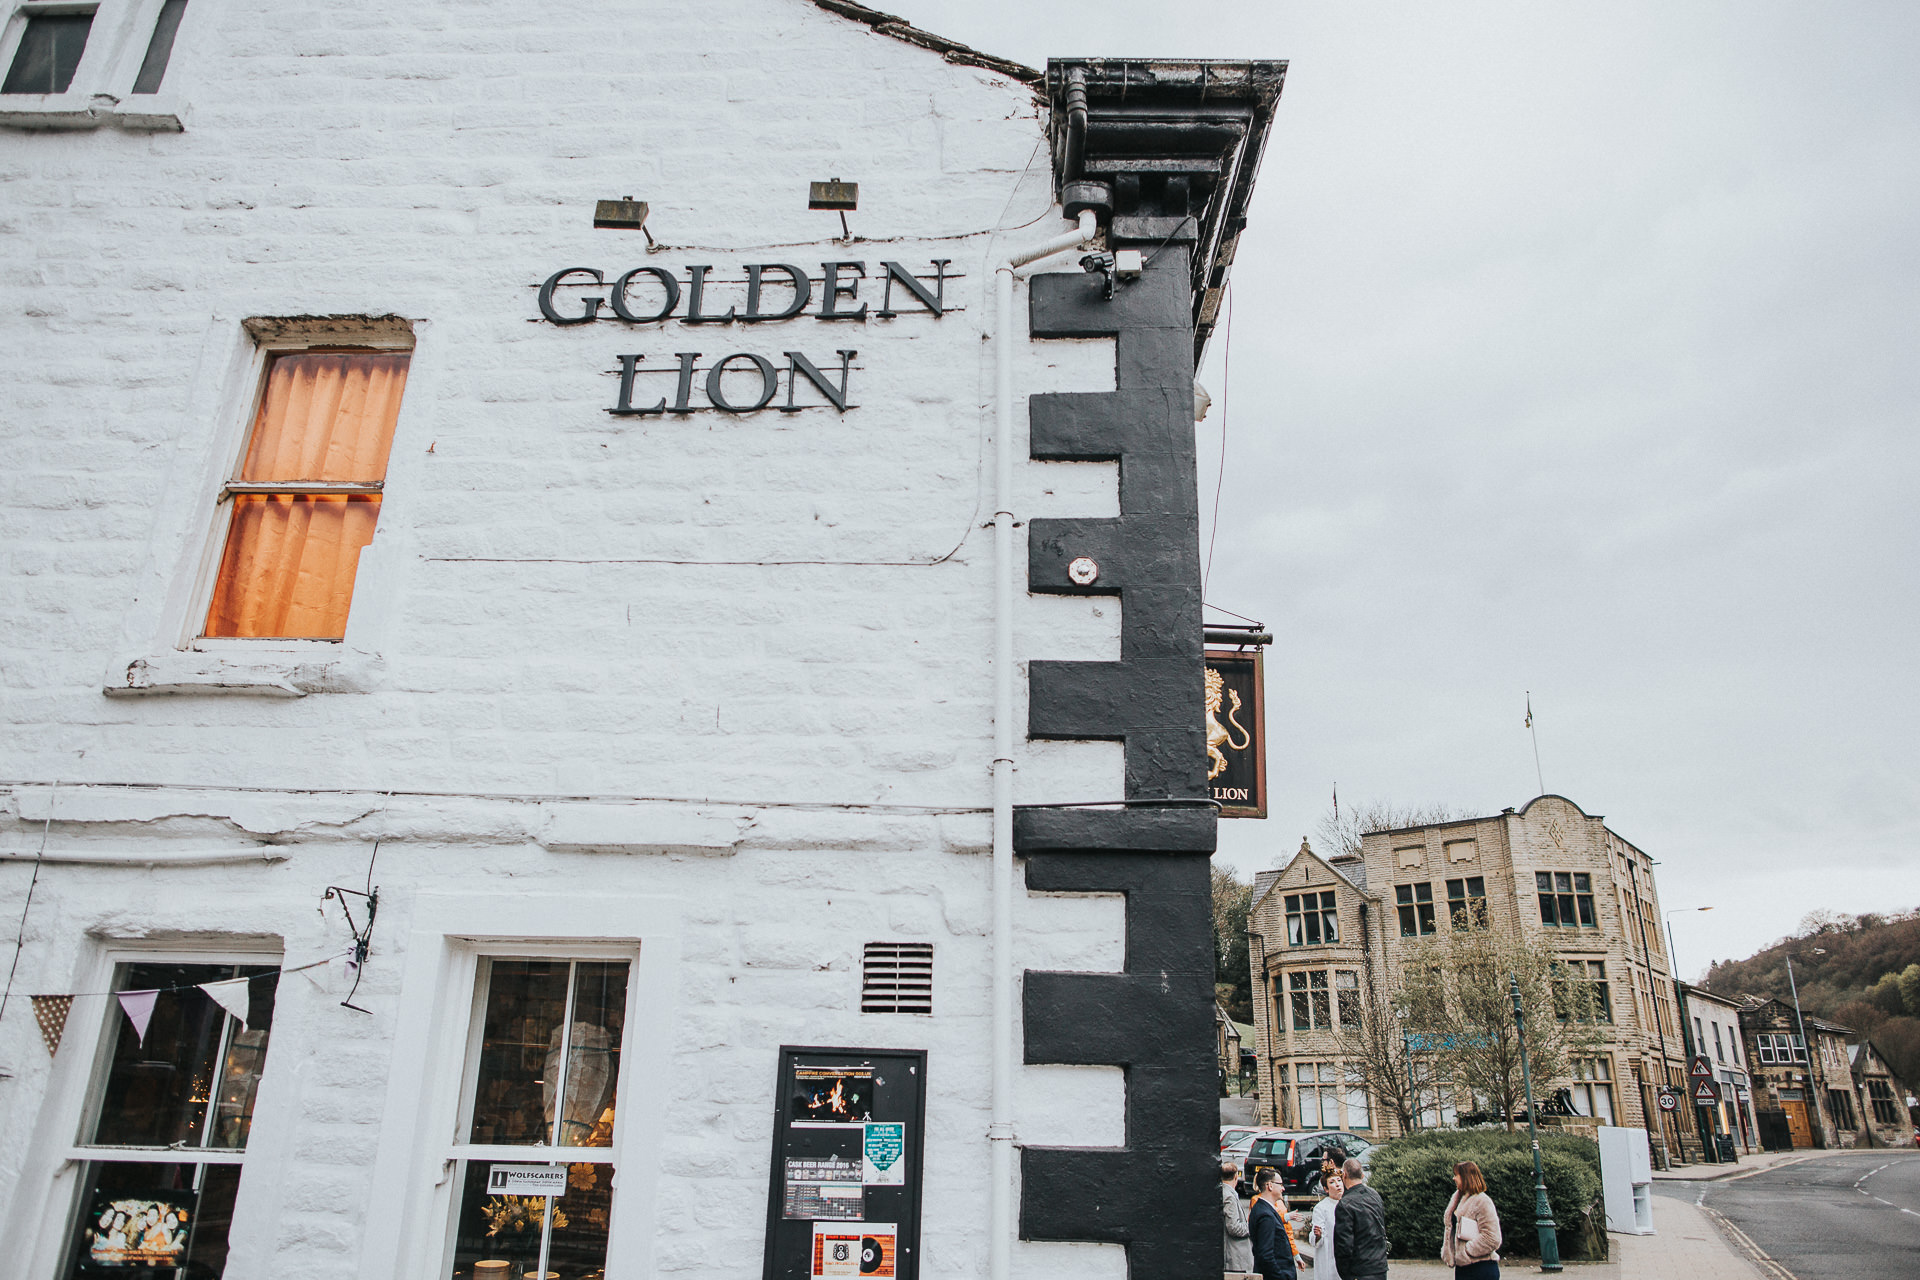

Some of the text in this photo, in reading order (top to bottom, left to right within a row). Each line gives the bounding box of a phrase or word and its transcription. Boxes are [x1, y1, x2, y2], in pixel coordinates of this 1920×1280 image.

[538, 259, 951, 325] GOLDEN
[609, 349, 858, 415] LION
[1213, 787, 1249, 801] LION
[1661, 1097, 1674, 1106] 30
[508, 1171, 564, 1179] WOLFSCARERS
